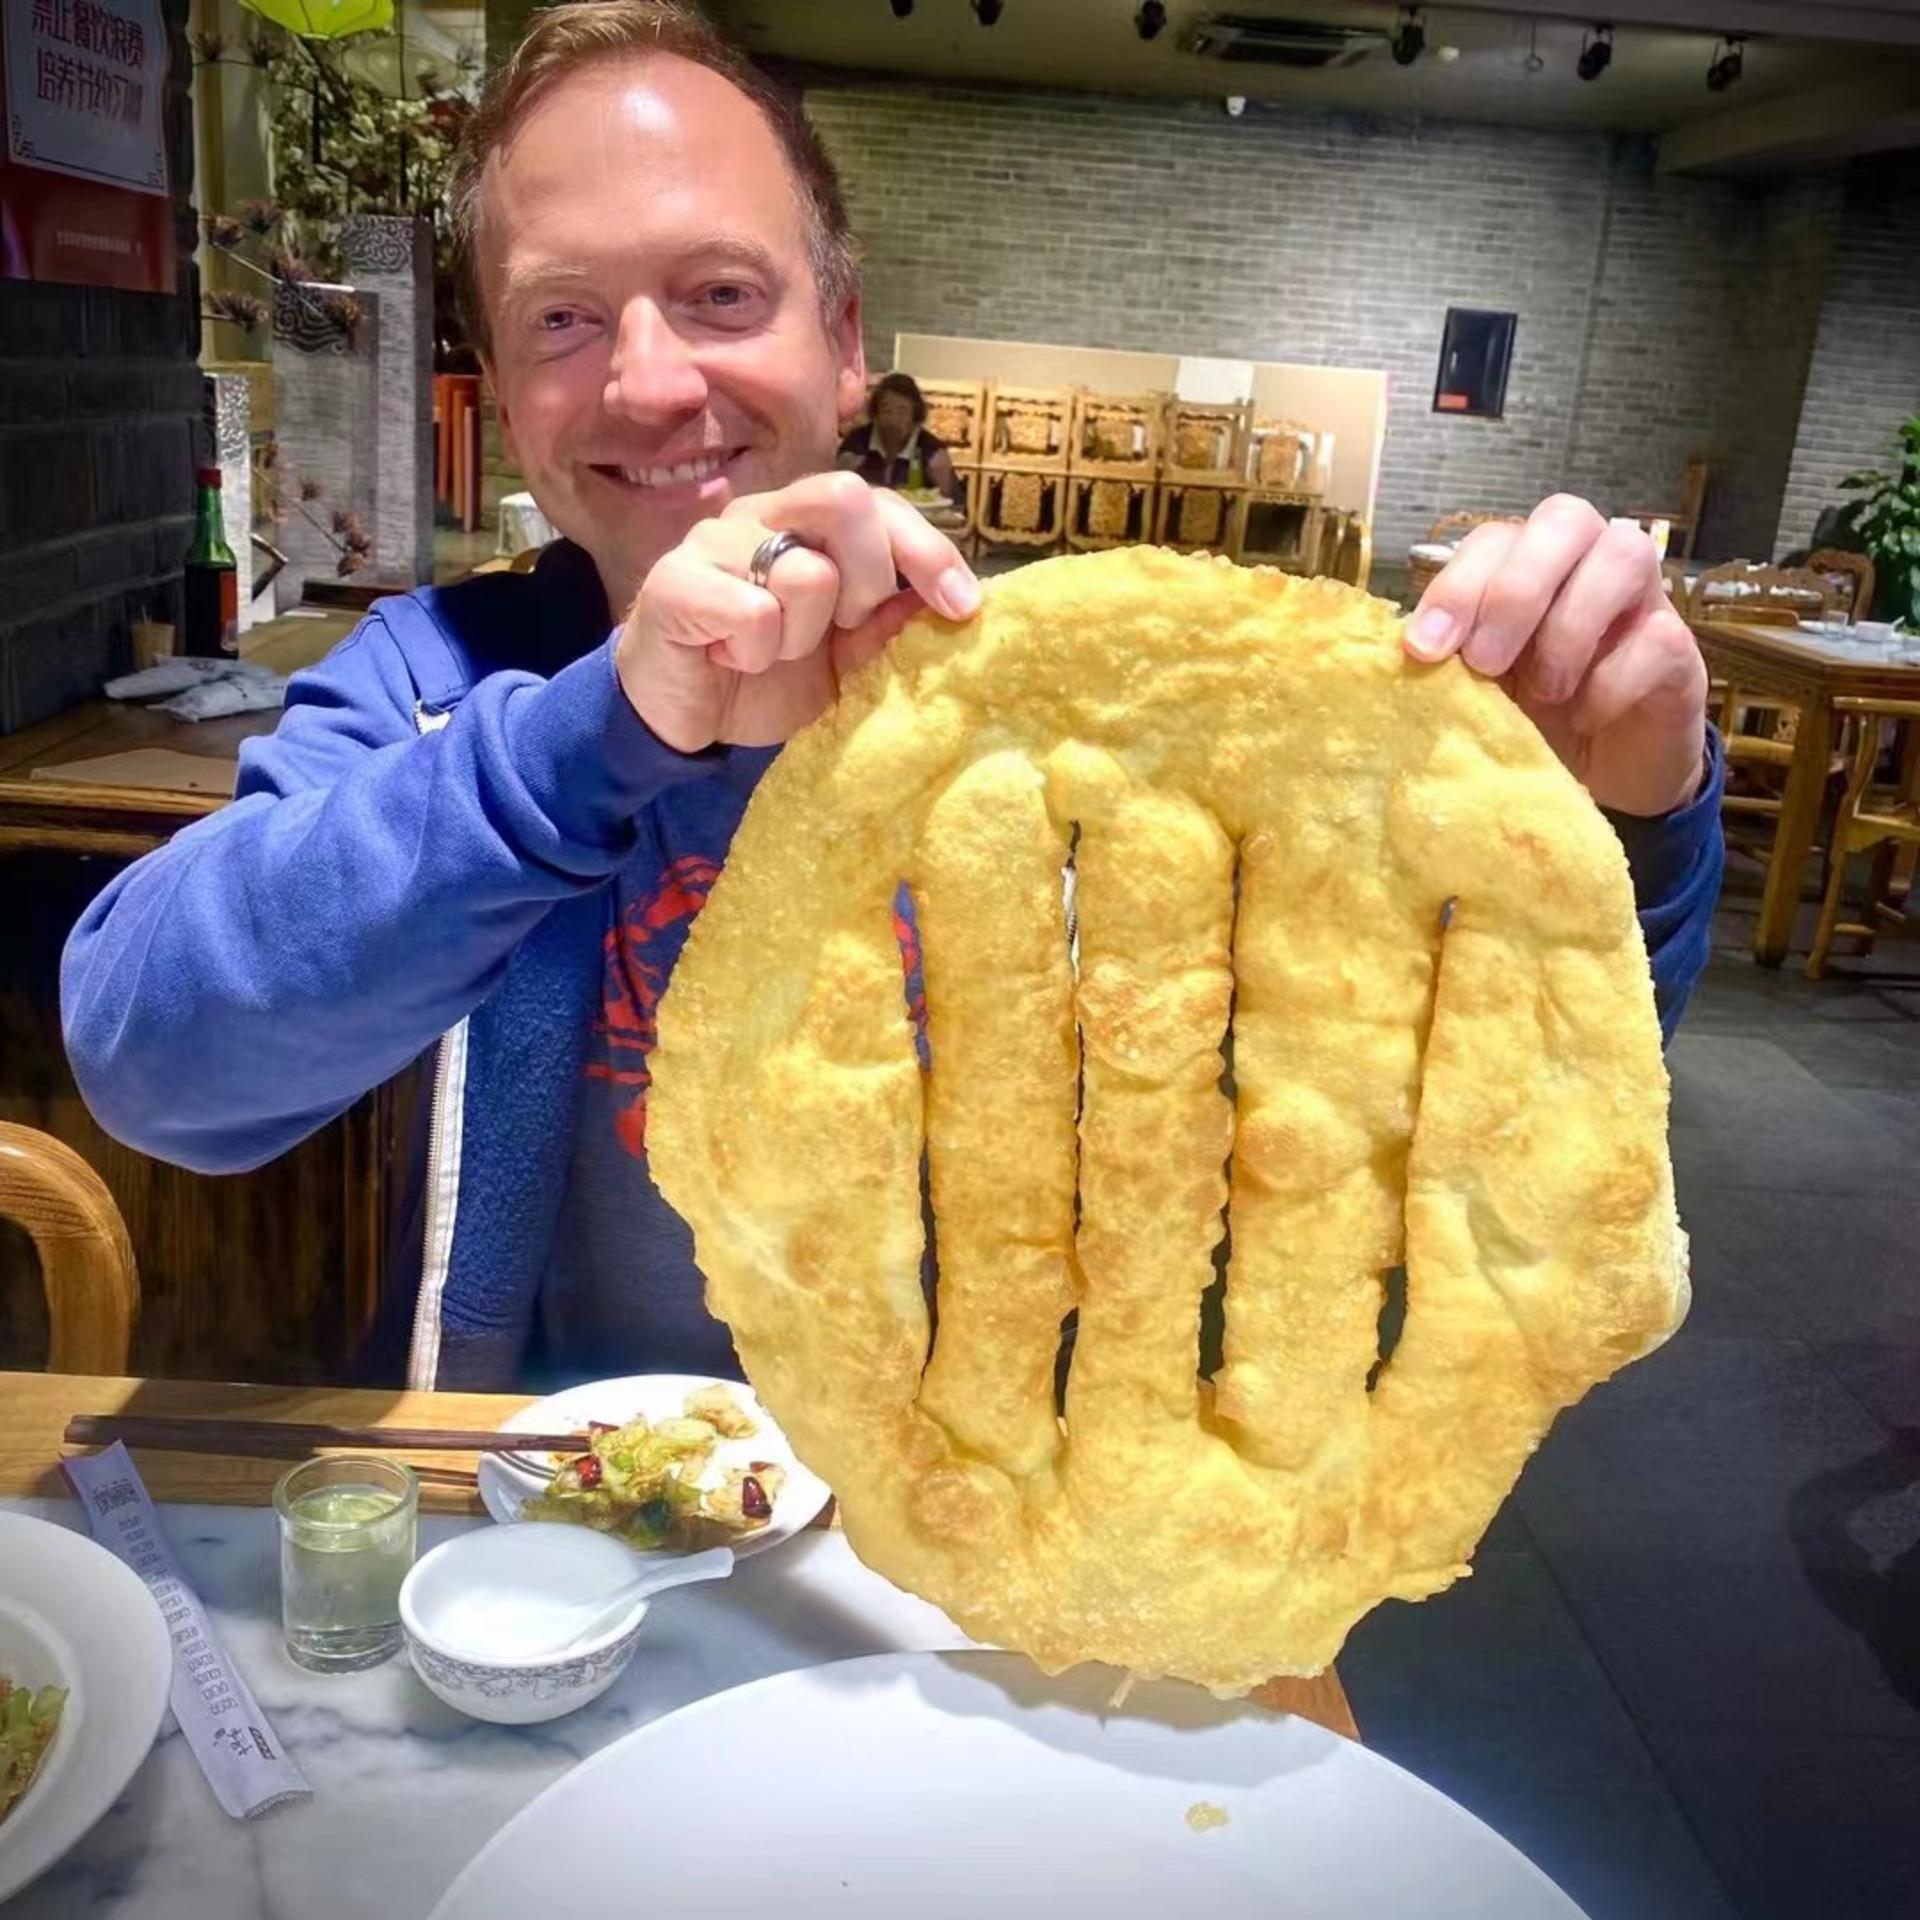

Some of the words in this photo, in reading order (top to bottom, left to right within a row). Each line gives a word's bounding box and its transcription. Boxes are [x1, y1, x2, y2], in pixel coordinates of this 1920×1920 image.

[36, 48, 143, 125] 培养节约习
